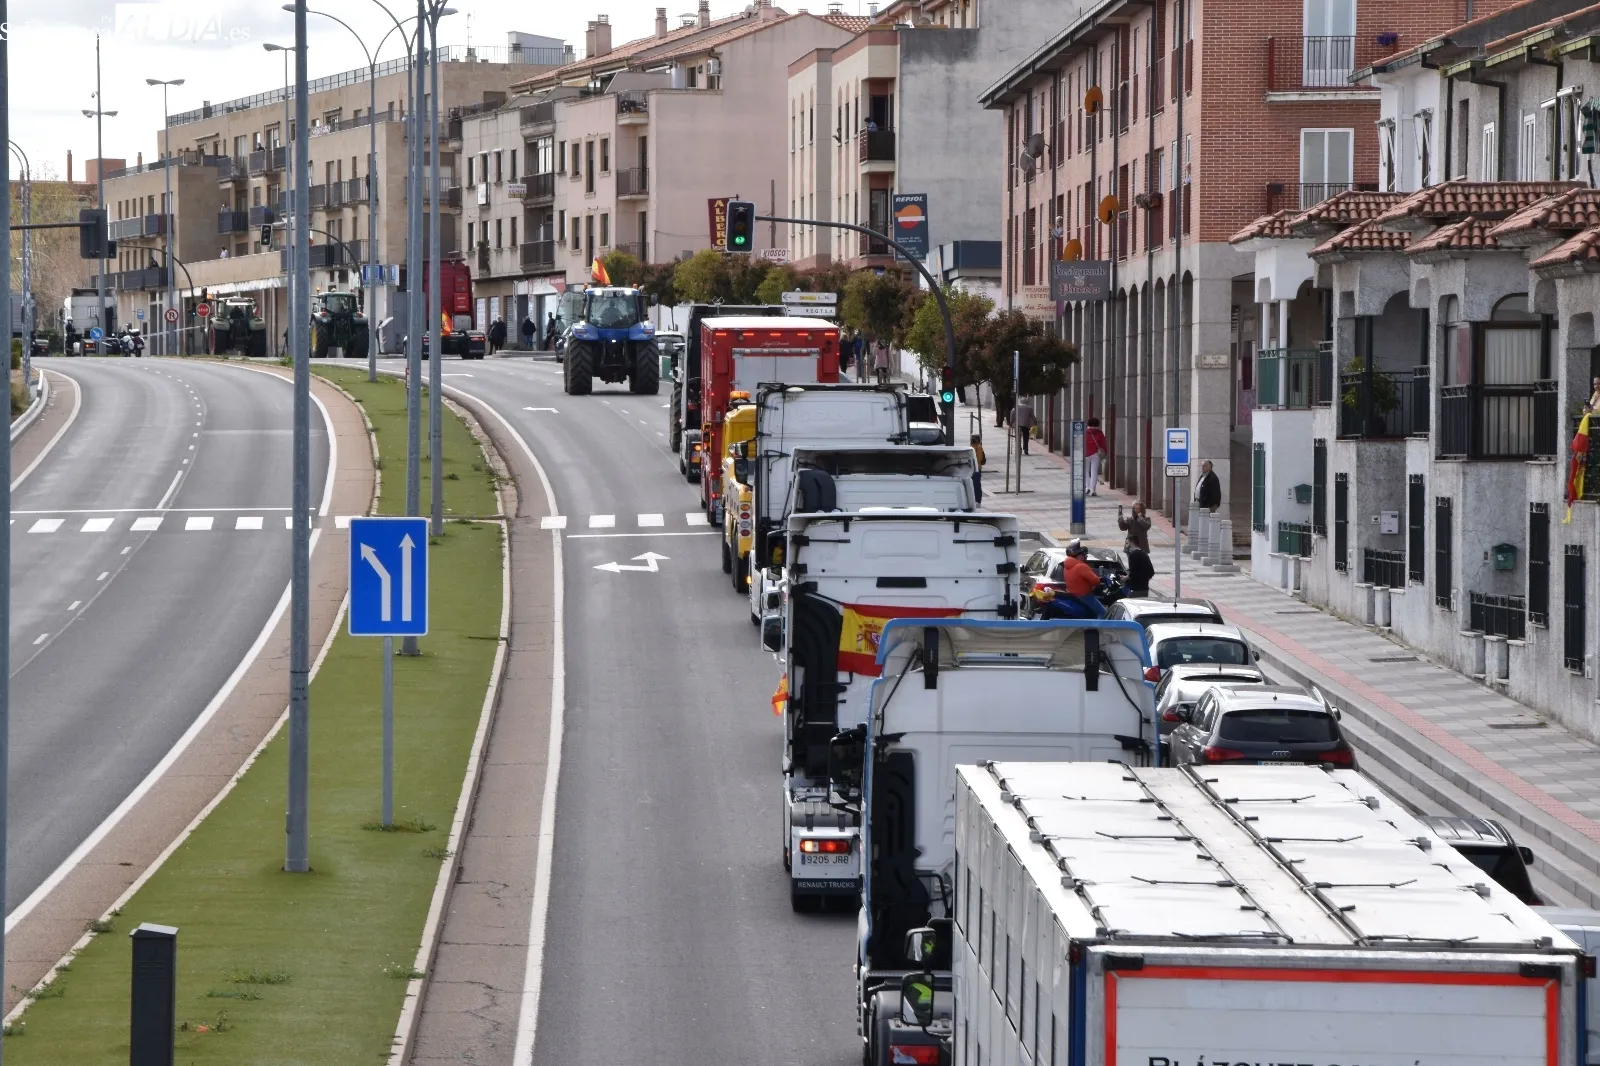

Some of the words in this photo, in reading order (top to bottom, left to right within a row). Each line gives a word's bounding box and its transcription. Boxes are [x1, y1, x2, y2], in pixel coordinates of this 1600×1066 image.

[714, 200, 726, 246] ALBERO
[763, 249, 786, 257] KIOSCO
[806, 855, 829, 864] 9205
[832, 855, 849, 864] JRB
